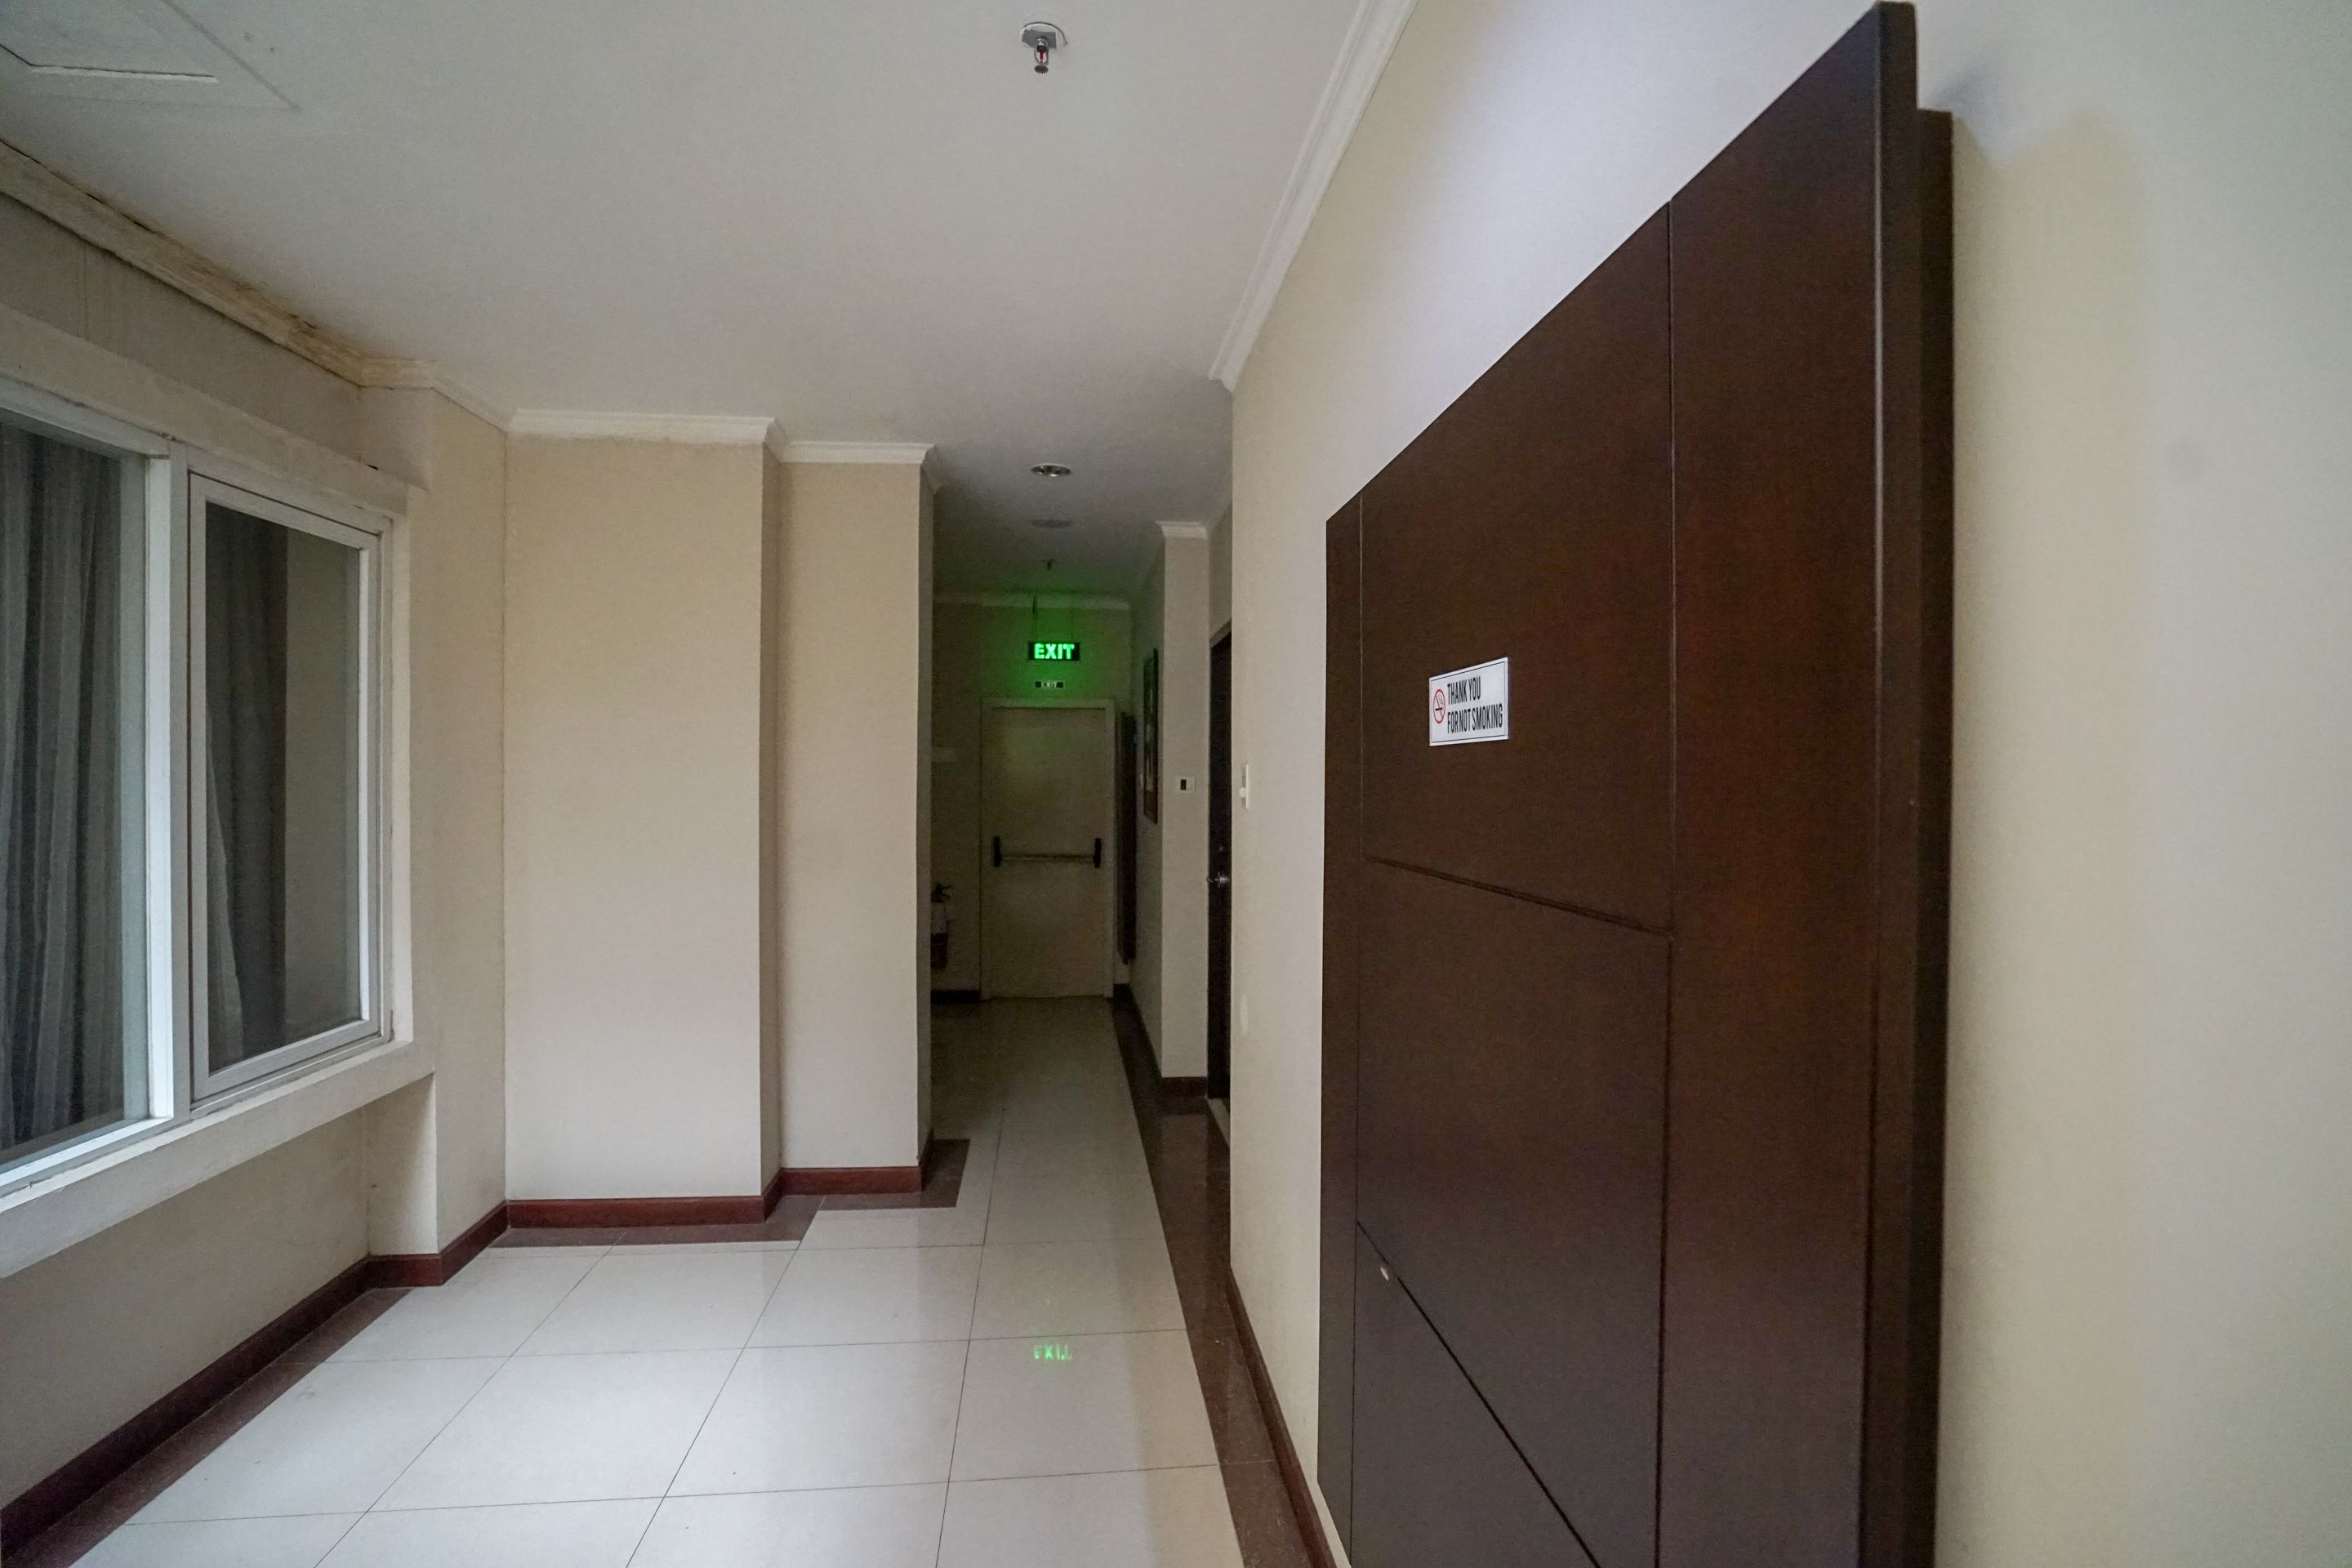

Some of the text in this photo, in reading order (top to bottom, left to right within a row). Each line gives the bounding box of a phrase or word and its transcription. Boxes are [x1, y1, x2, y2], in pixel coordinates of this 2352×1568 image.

[1034, 643, 1075, 659] EXIT
[1447, 676, 1481, 705] THANK YOU
[1448, 703, 1503, 734] FOR NOT SMOKING
